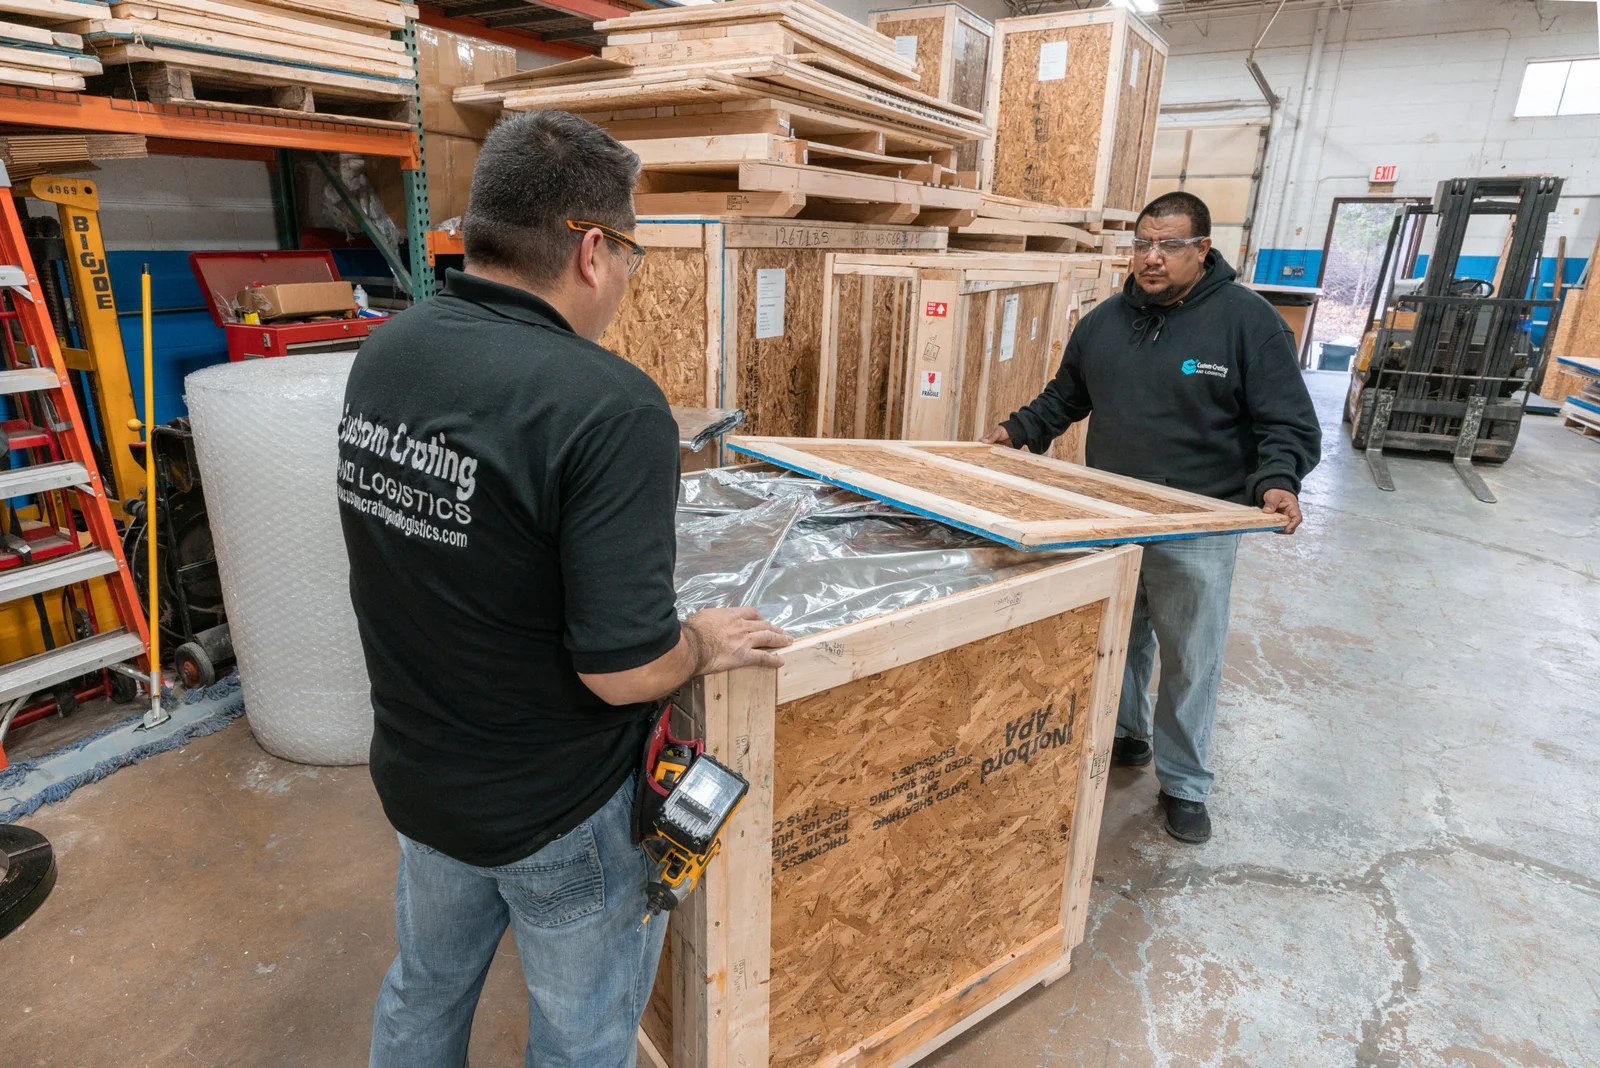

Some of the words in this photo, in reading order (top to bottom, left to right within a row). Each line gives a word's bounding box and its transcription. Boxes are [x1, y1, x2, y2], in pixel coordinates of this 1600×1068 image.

[1374, 165, 1397, 180] EXIT
[47, 186, 77, 195] 4969
[922, 390, 939, 398] FRAGILE
[390, 422, 478, 501] Crating
[359, 467, 472, 524] LOGISTICS
[1005, 703, 1053, 747] APA
[944, 753, 973, 774] SIZED
[981, 723, 1067, 784] Norbord
[920, 767, 942, 784] FOR
[869, 776, 917, 806] SPACING
[936, 779, 969, 802] RATED
[801, 806, 850, 835] PRP-108
[872, 795, 933, 830] SHEATHING
[781, 834, 850, 872] THICKNESS
